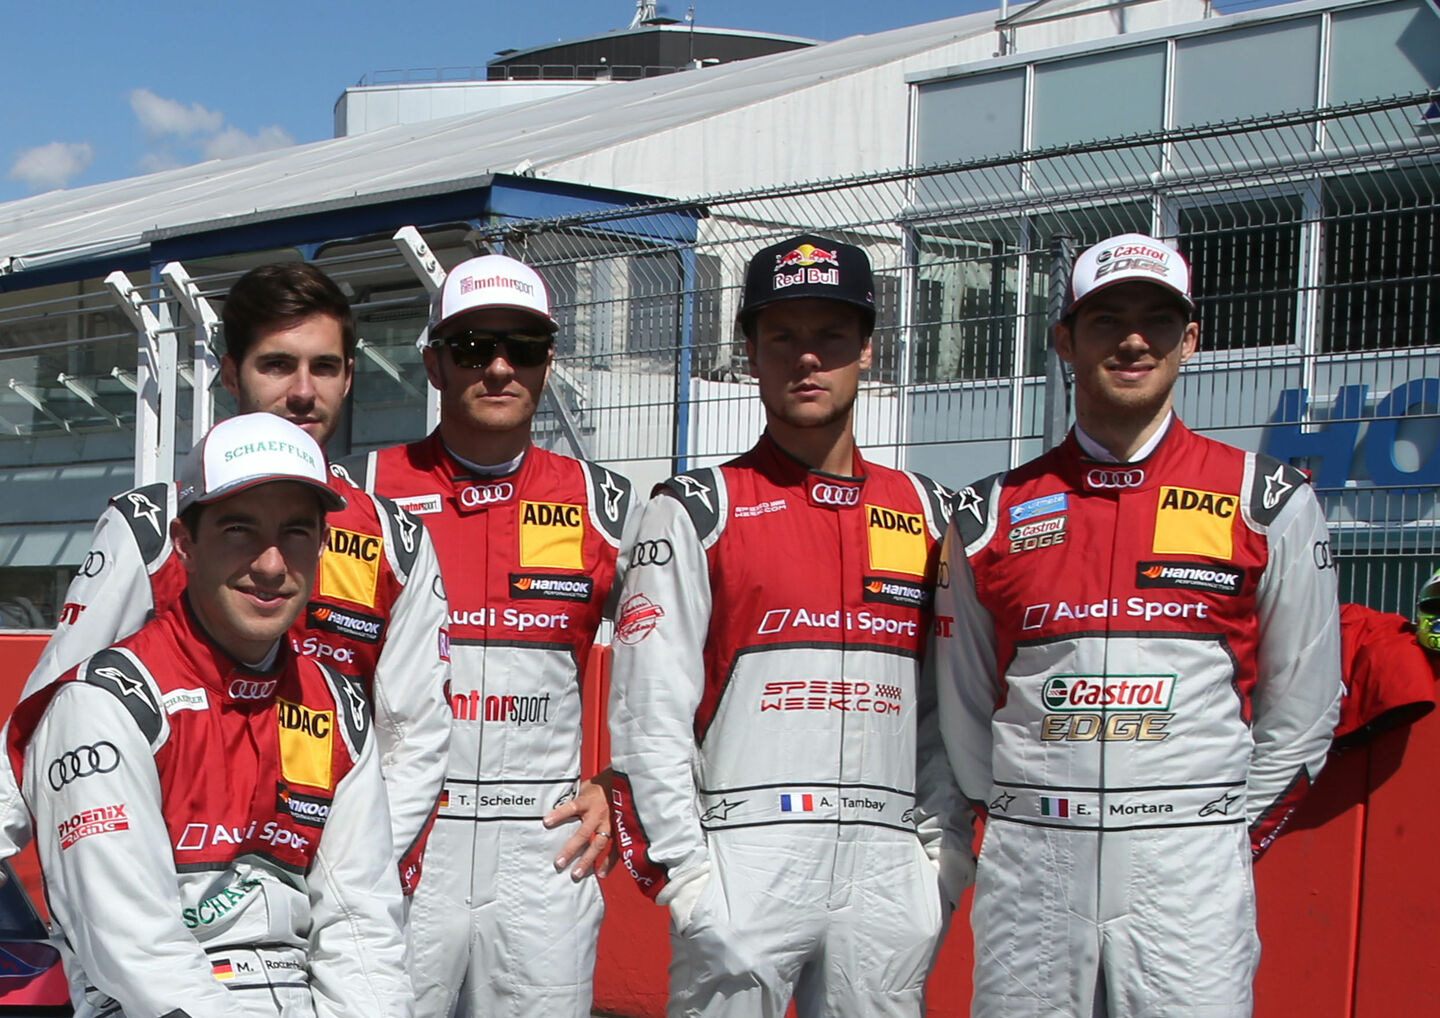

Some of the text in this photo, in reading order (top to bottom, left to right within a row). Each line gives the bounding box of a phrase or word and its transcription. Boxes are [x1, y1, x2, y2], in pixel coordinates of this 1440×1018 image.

[1113, 245, 1164, 261] Castrol
[773, 267, 839, 290] Red Bull
[1094, 258, 1170, 281] EDGE
[225, 440, 315, 468] SCHAEFFLER
[1161, 489, 1234, 518] ADAC
[523, 504, 580, 527] ADAC
[870, 508, 922, 536] ADAC
[1022, 519, 1061, 537] Castrol
[1010, 531, 1066, 554] EDGE
[503, 608, 568, 631] Sport
[1053, 597, 1208, 621] Audi Sport
[792, 608, 853, 630] Audi
[858, 612, 917, 636] Sport
[763, 680, 870, 696] SPEED
[1069, 680, 1164, 706] Castrol
[760, 697, 902, 716] WEEK.COM
[278, 701, 329, 739] ADAC
[1041, 712, 1177, 742] EDGE
[458, 794, 536, 806] T. Scheider
[820, 797, 886, 812] A. Tambay
[1077, 803, 1173, 816] E. Mortara
[237, 963, 254, 973] M.
